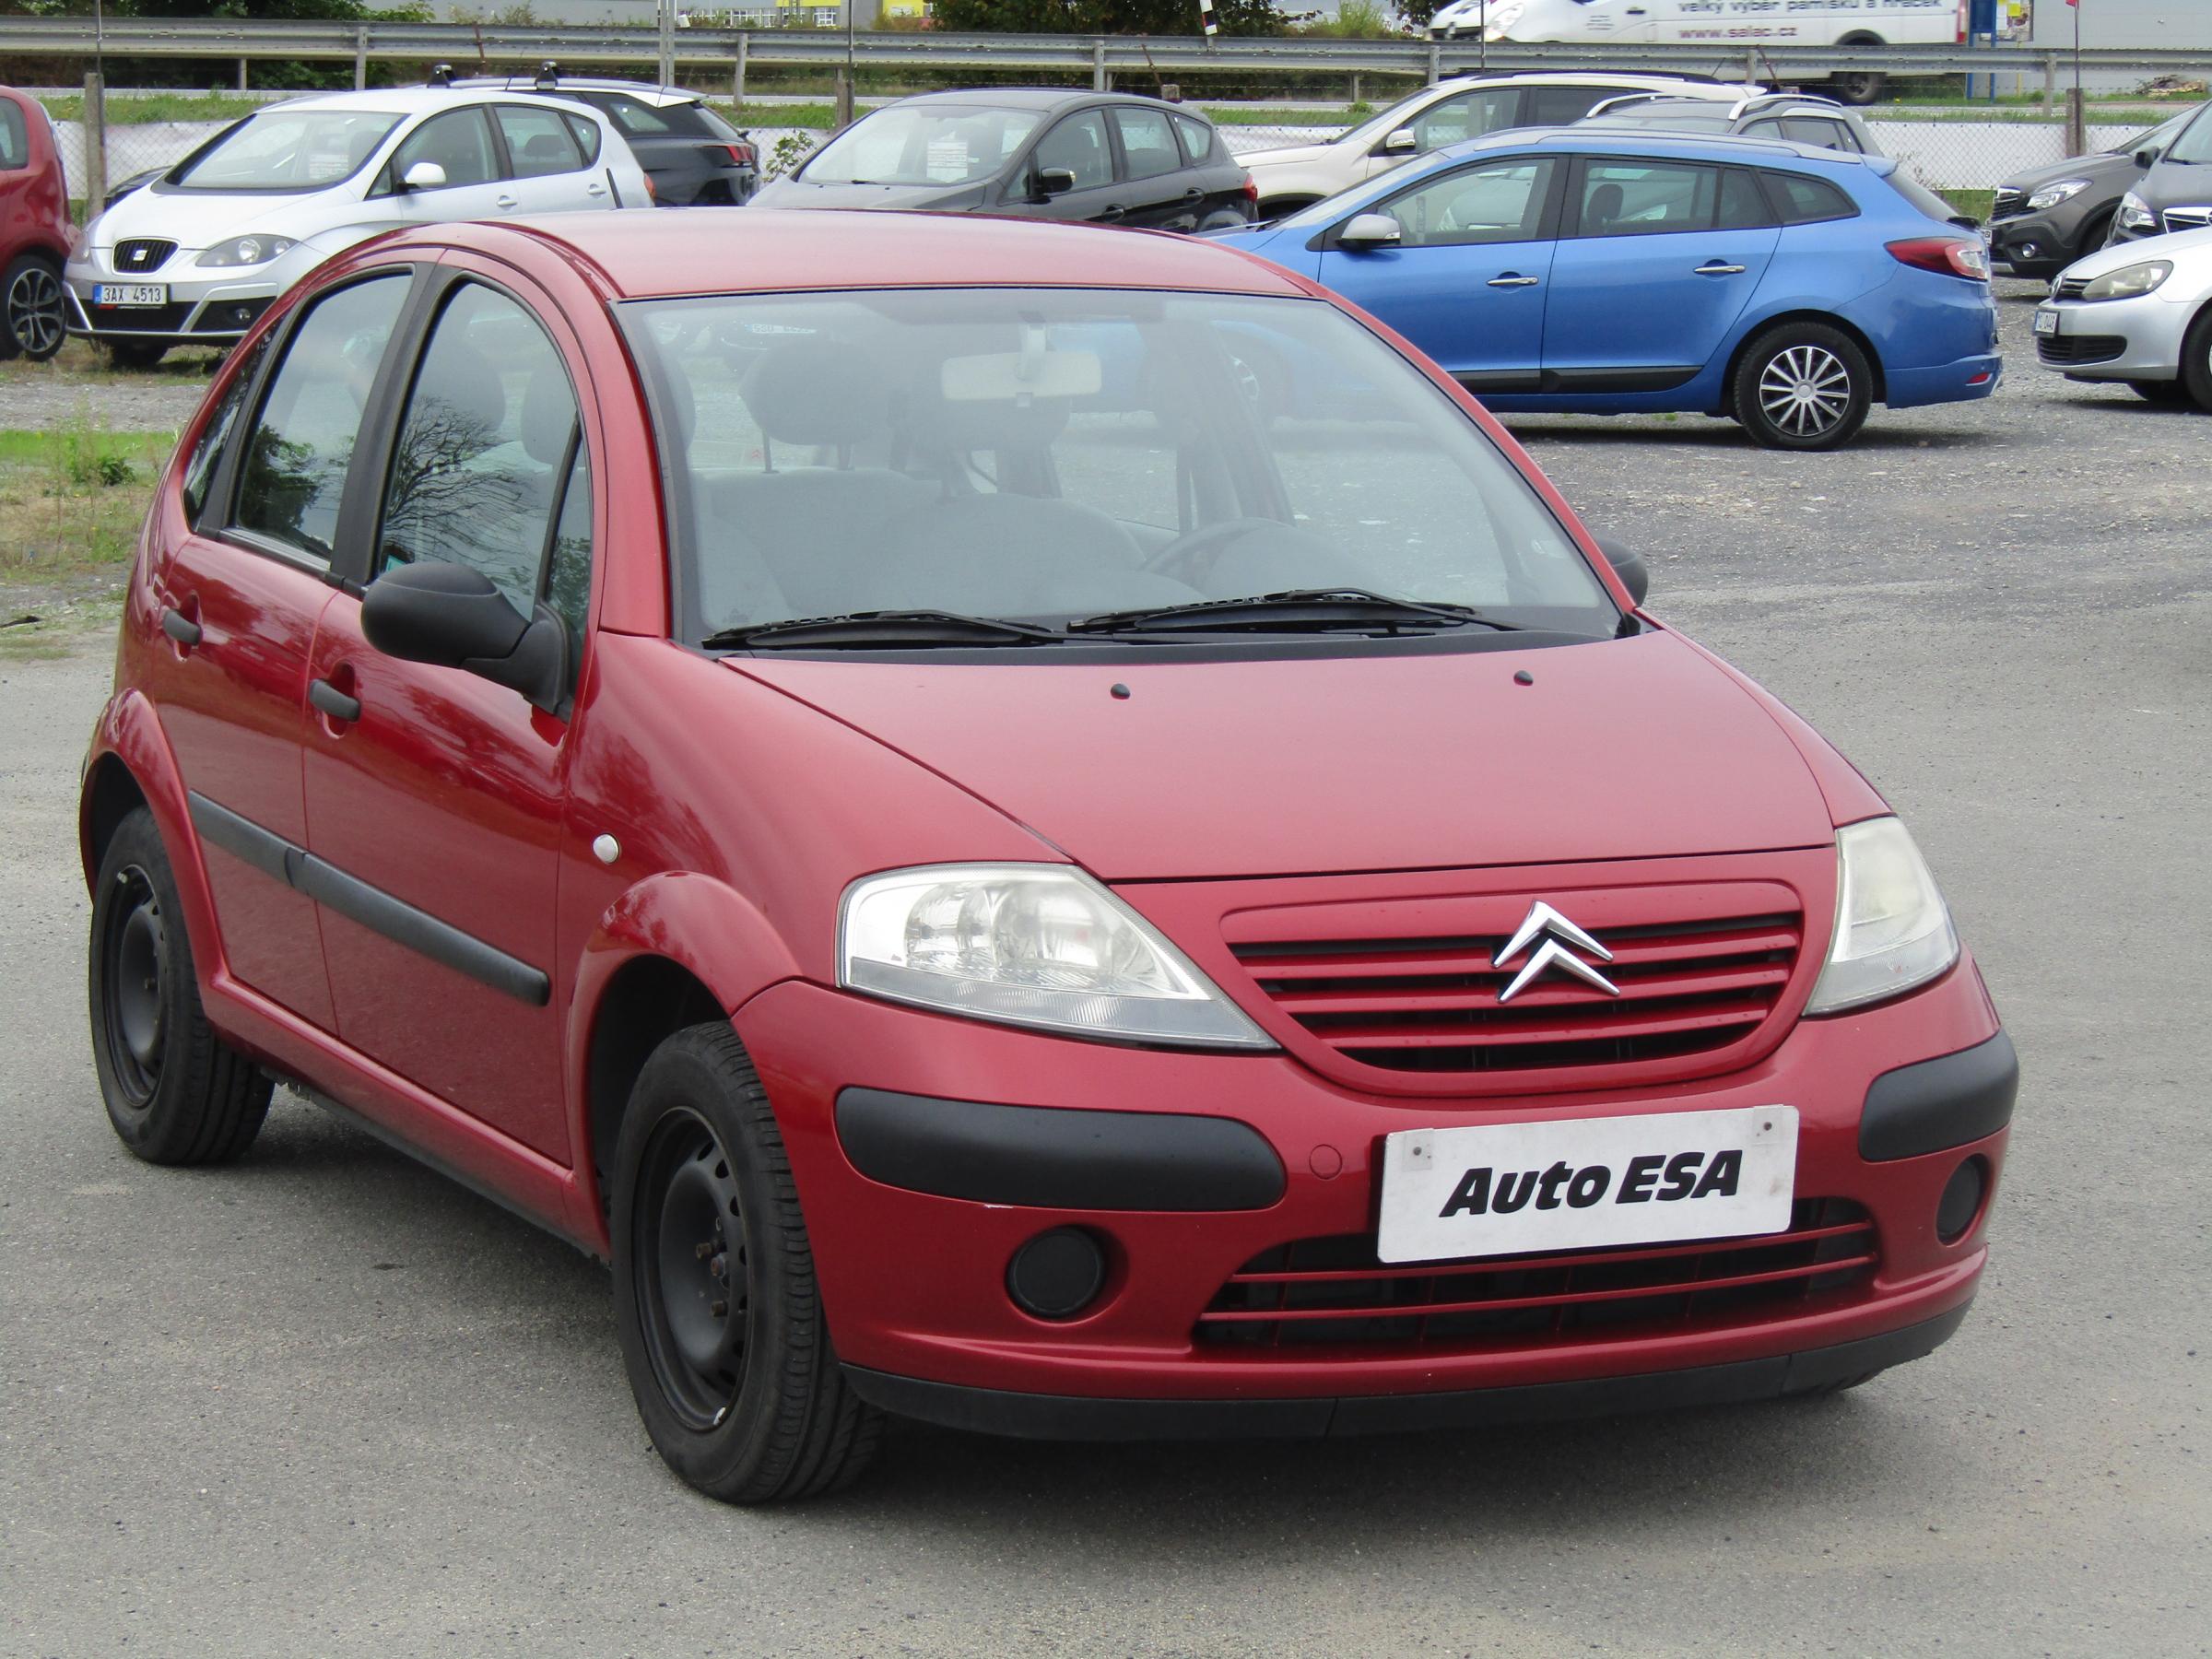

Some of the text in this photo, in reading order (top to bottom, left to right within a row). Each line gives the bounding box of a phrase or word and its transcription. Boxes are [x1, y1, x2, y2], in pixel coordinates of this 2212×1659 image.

[103, 287, 161, 303] 3AX 4513
[1439, 1149, 1743, 1218] Auto ESA
